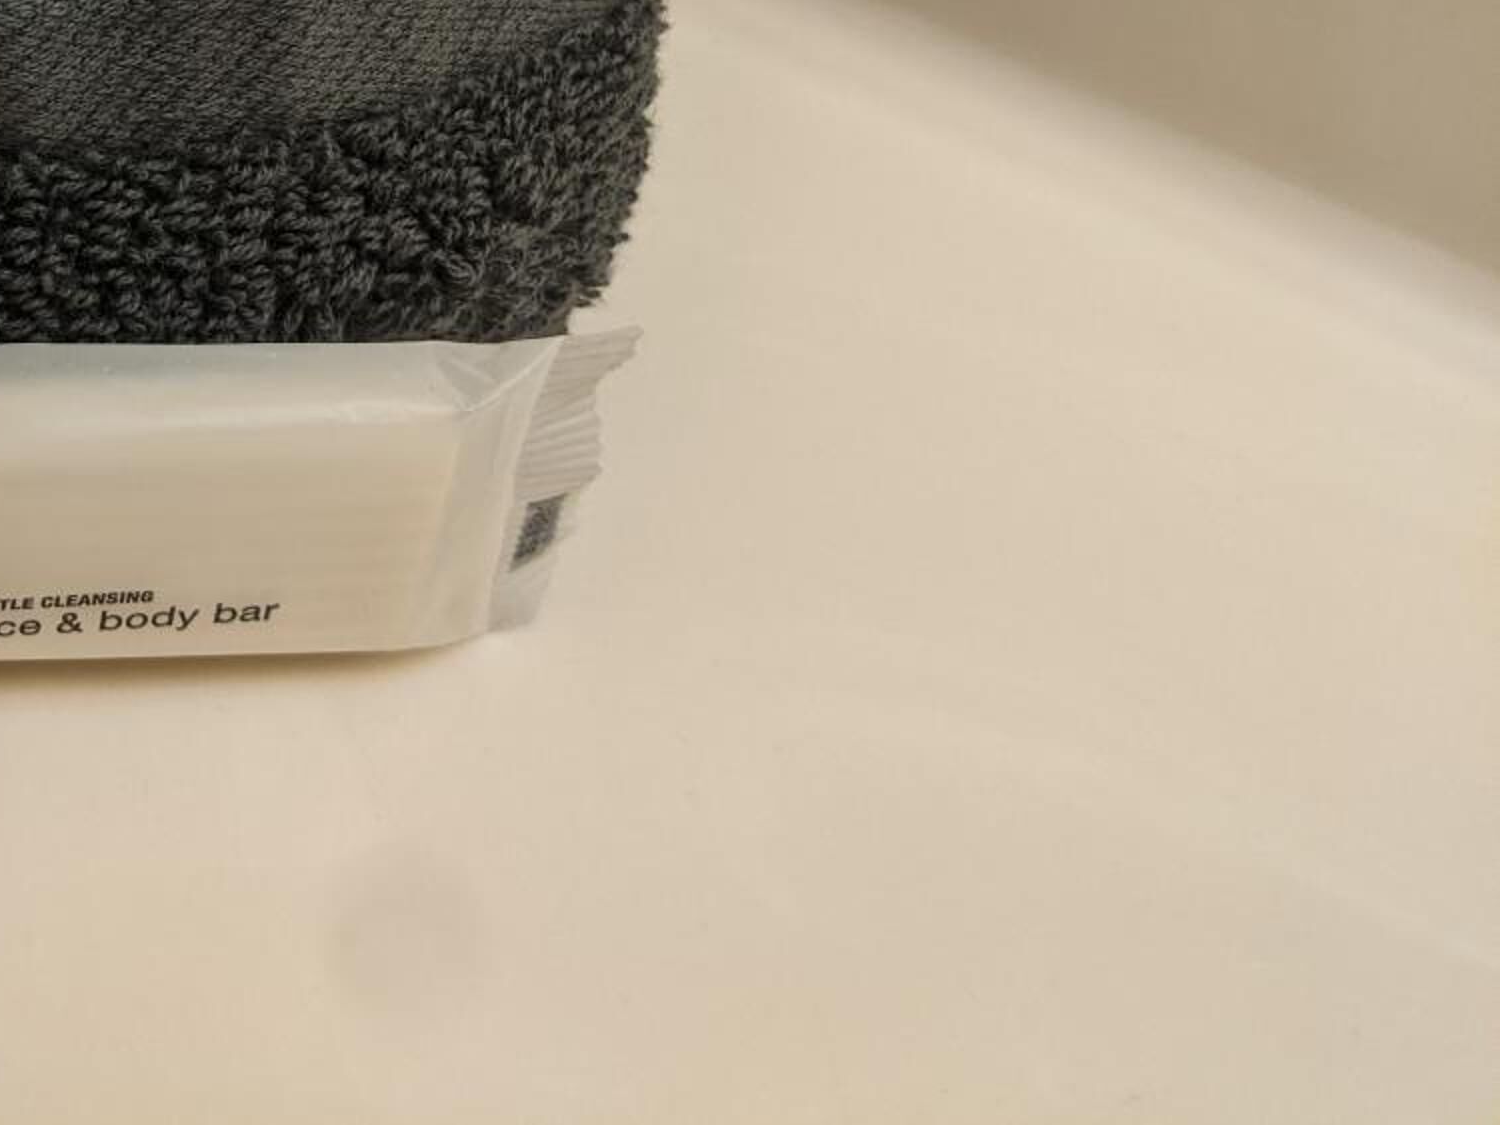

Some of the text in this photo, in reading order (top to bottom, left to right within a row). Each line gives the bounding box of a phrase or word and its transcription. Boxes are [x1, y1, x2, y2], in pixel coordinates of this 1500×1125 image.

[41, 590, 155, 609] CLEANSING
[56, 612, 83, 635] &
[99, 606, 200, 632] body
[213, 603, 280, 625] bar
